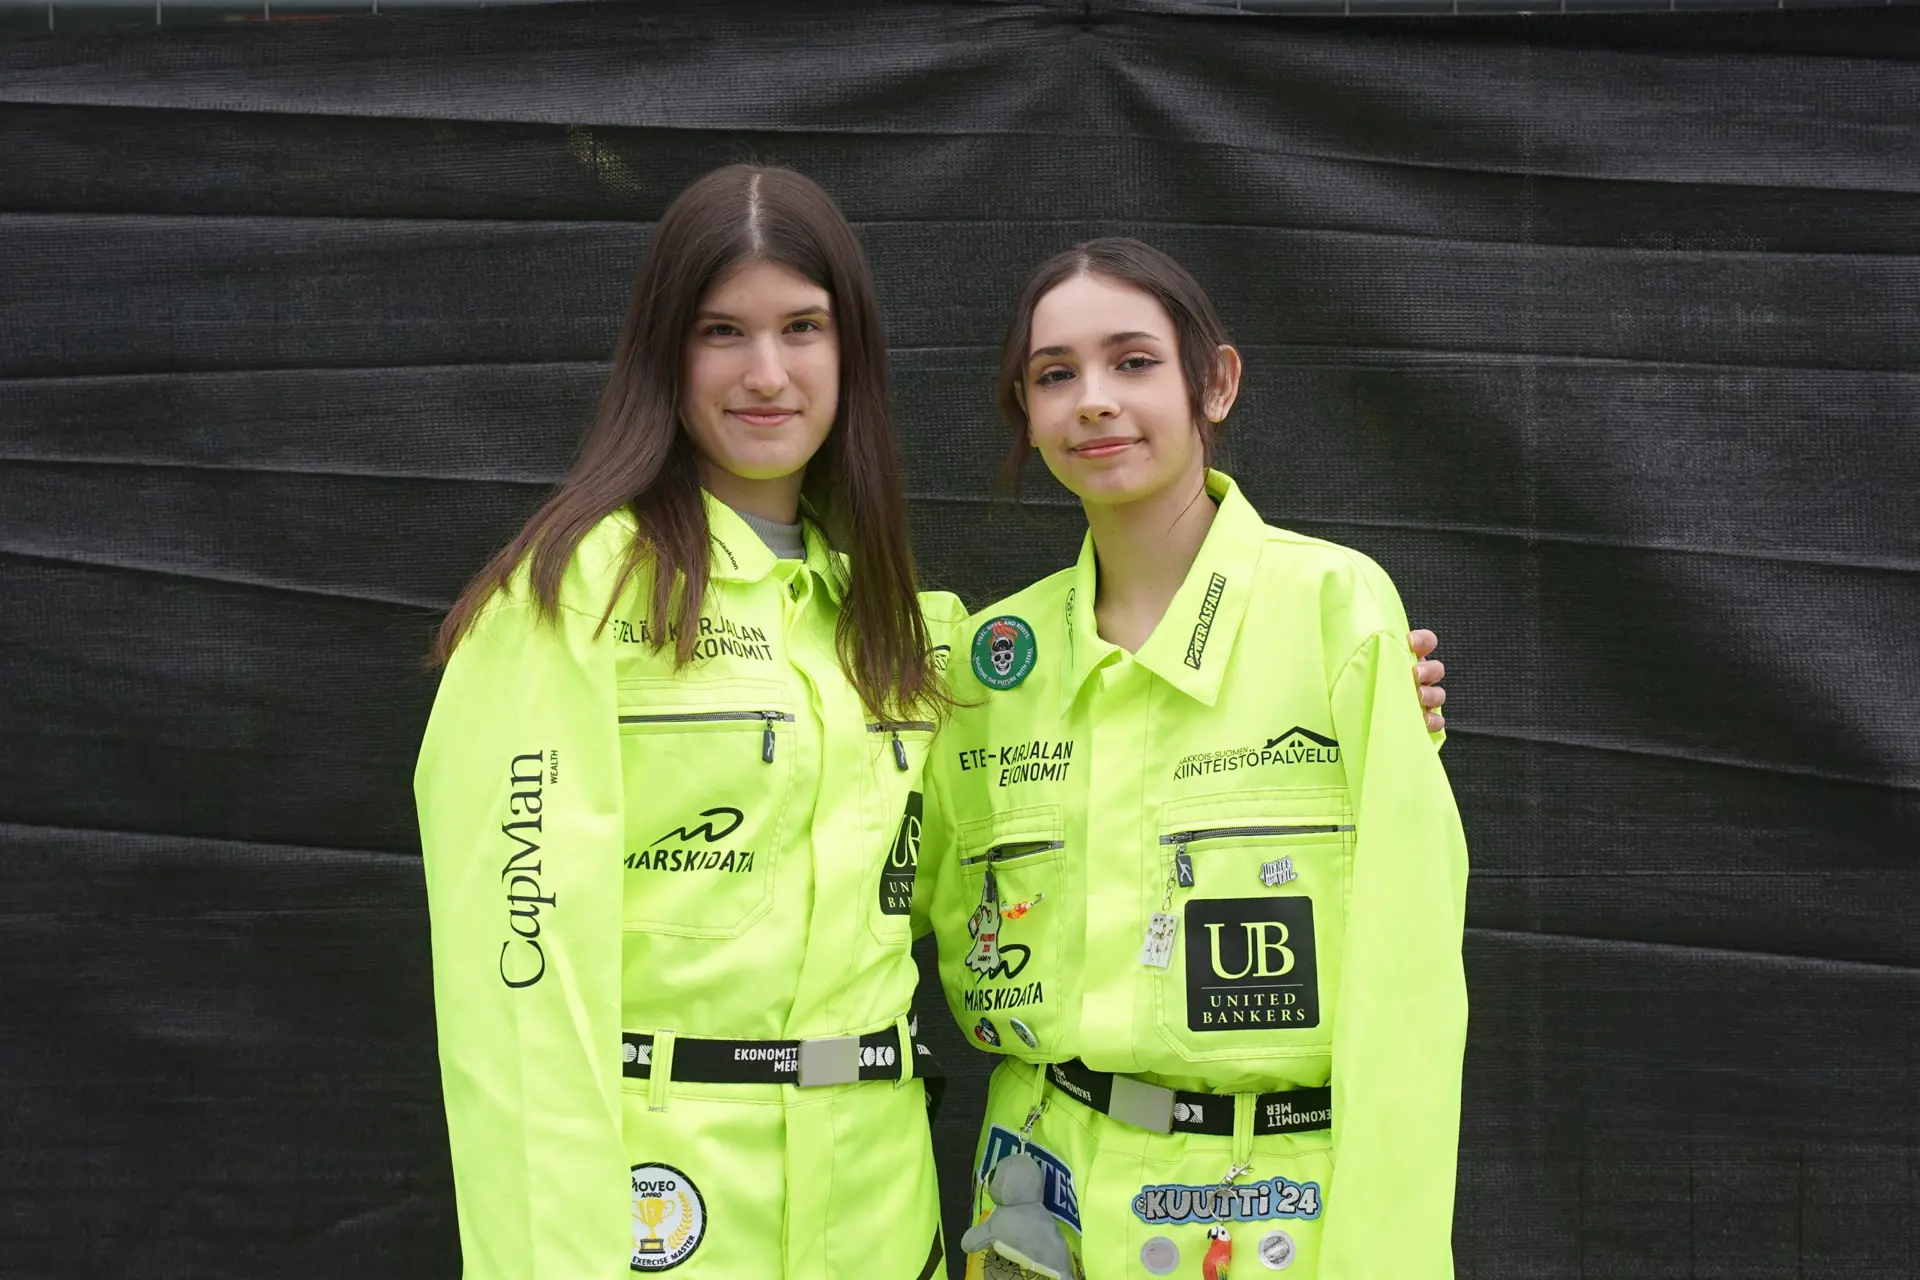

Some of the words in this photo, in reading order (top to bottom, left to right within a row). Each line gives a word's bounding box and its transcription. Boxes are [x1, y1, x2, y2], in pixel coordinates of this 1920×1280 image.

[1186, 625, 1209, 667] POWER
[1199, 577, 1225, 624] ASFALTTI
[690, 637, 773, 661] KONOMIT
[987, 676, 997, 685] THE
[997, 676, 1017, 685] FUTURE
[549, 749, 559, 785] WEALTH
[998, 762, 1071, 787] EKONOMIT
[1173, 748, 1339, 781] KIINTEISTÖPALVELU
[499, 749, 557, 989] CapMan
[624, 849, 755, 873] MARSKIDATA
[1203, 921, 1295, 980] UB
[964, 981, 1044, 1012] MARSKIDATA
[1210, 993, 1297, 1008] UNITED
[1202, 1008, 1306, 1024] BANKERS
[734, 1047, 798, 1061] EKONOMIT
[773, 1060, 798, 1072] MER
[1266, 1102, 1292, 1116] MER
[1267, 1109, 1332, 1128] EKONOMIT
[1274, 1180, 1318, 1215] '24
[631, 1255, 669, 1267] EXERCISE
[670, 1234, 696, 1261] MASTER
